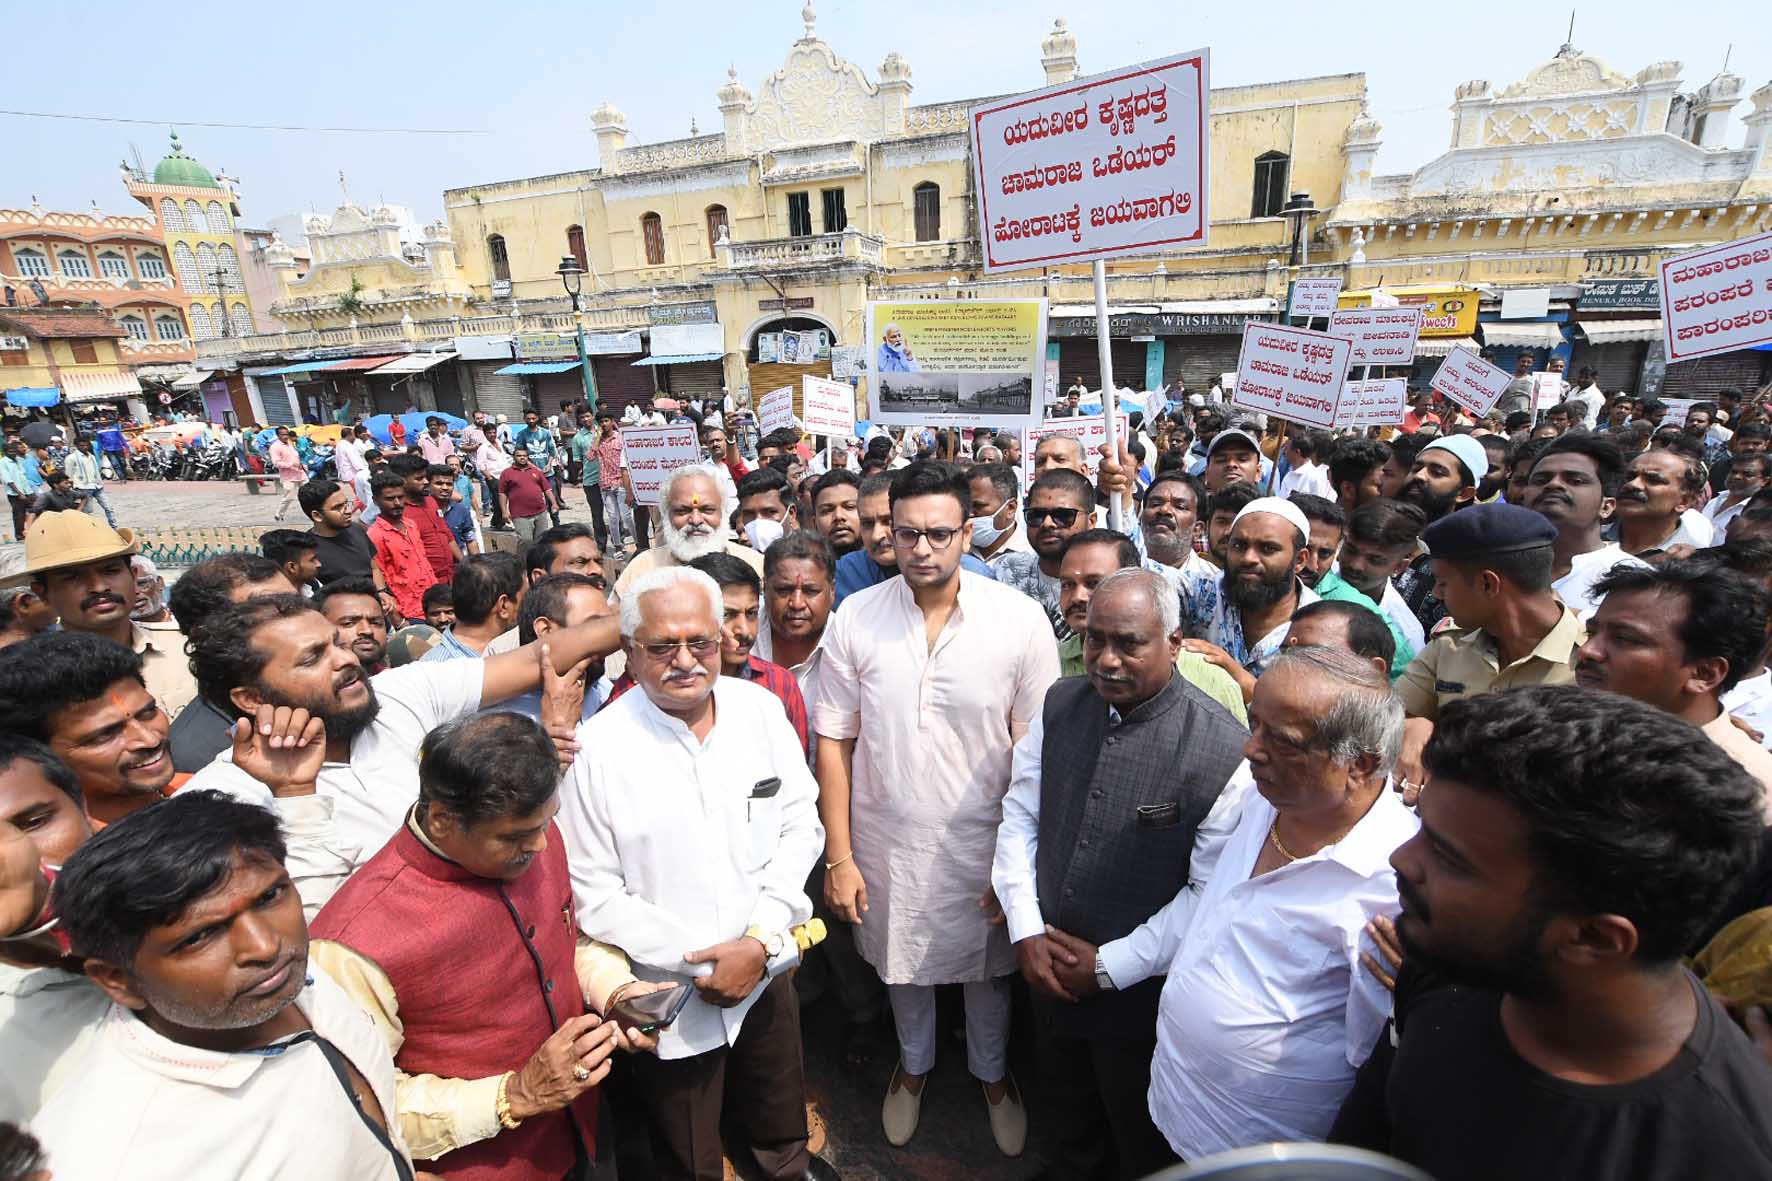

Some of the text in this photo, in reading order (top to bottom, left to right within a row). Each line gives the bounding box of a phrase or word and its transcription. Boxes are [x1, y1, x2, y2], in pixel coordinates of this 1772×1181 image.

[1004, 83, 1167, 145] ಯದುವೀರ ಕೃಷ್ಣದತ್ತ
[1002, 135, 1175, 195] ಚಾಮರಾಜ ಒಡೆಯರ್
[994, 187, 1192, 243] ಹೋರಾಟಕ್ಕೆ ಜಯವಾಗಲಿ
[1672, 248, 1772, 284] ಮಹಾರಾಜ
[1621, 281, 1647, 295] ಬುಕ್
[1674, 278, 1752, 313] ಪರಂಪರೆ
[1375, 313, 1416, 327] ಮಾರುಕಟ್ಟೆ
[1258, 335, 1335, 365] ಯದುವೀರ ಕೃಷ್ಣದತ್ತ
[1250, 359, 1332, 385] ಚಾಮರಾಜ ಒಡೆಯರ್
[1240, 379, 1332, 412] ಹೋರಾಟಕ್ಕೆ ಜಯವಾಗಲಿ
